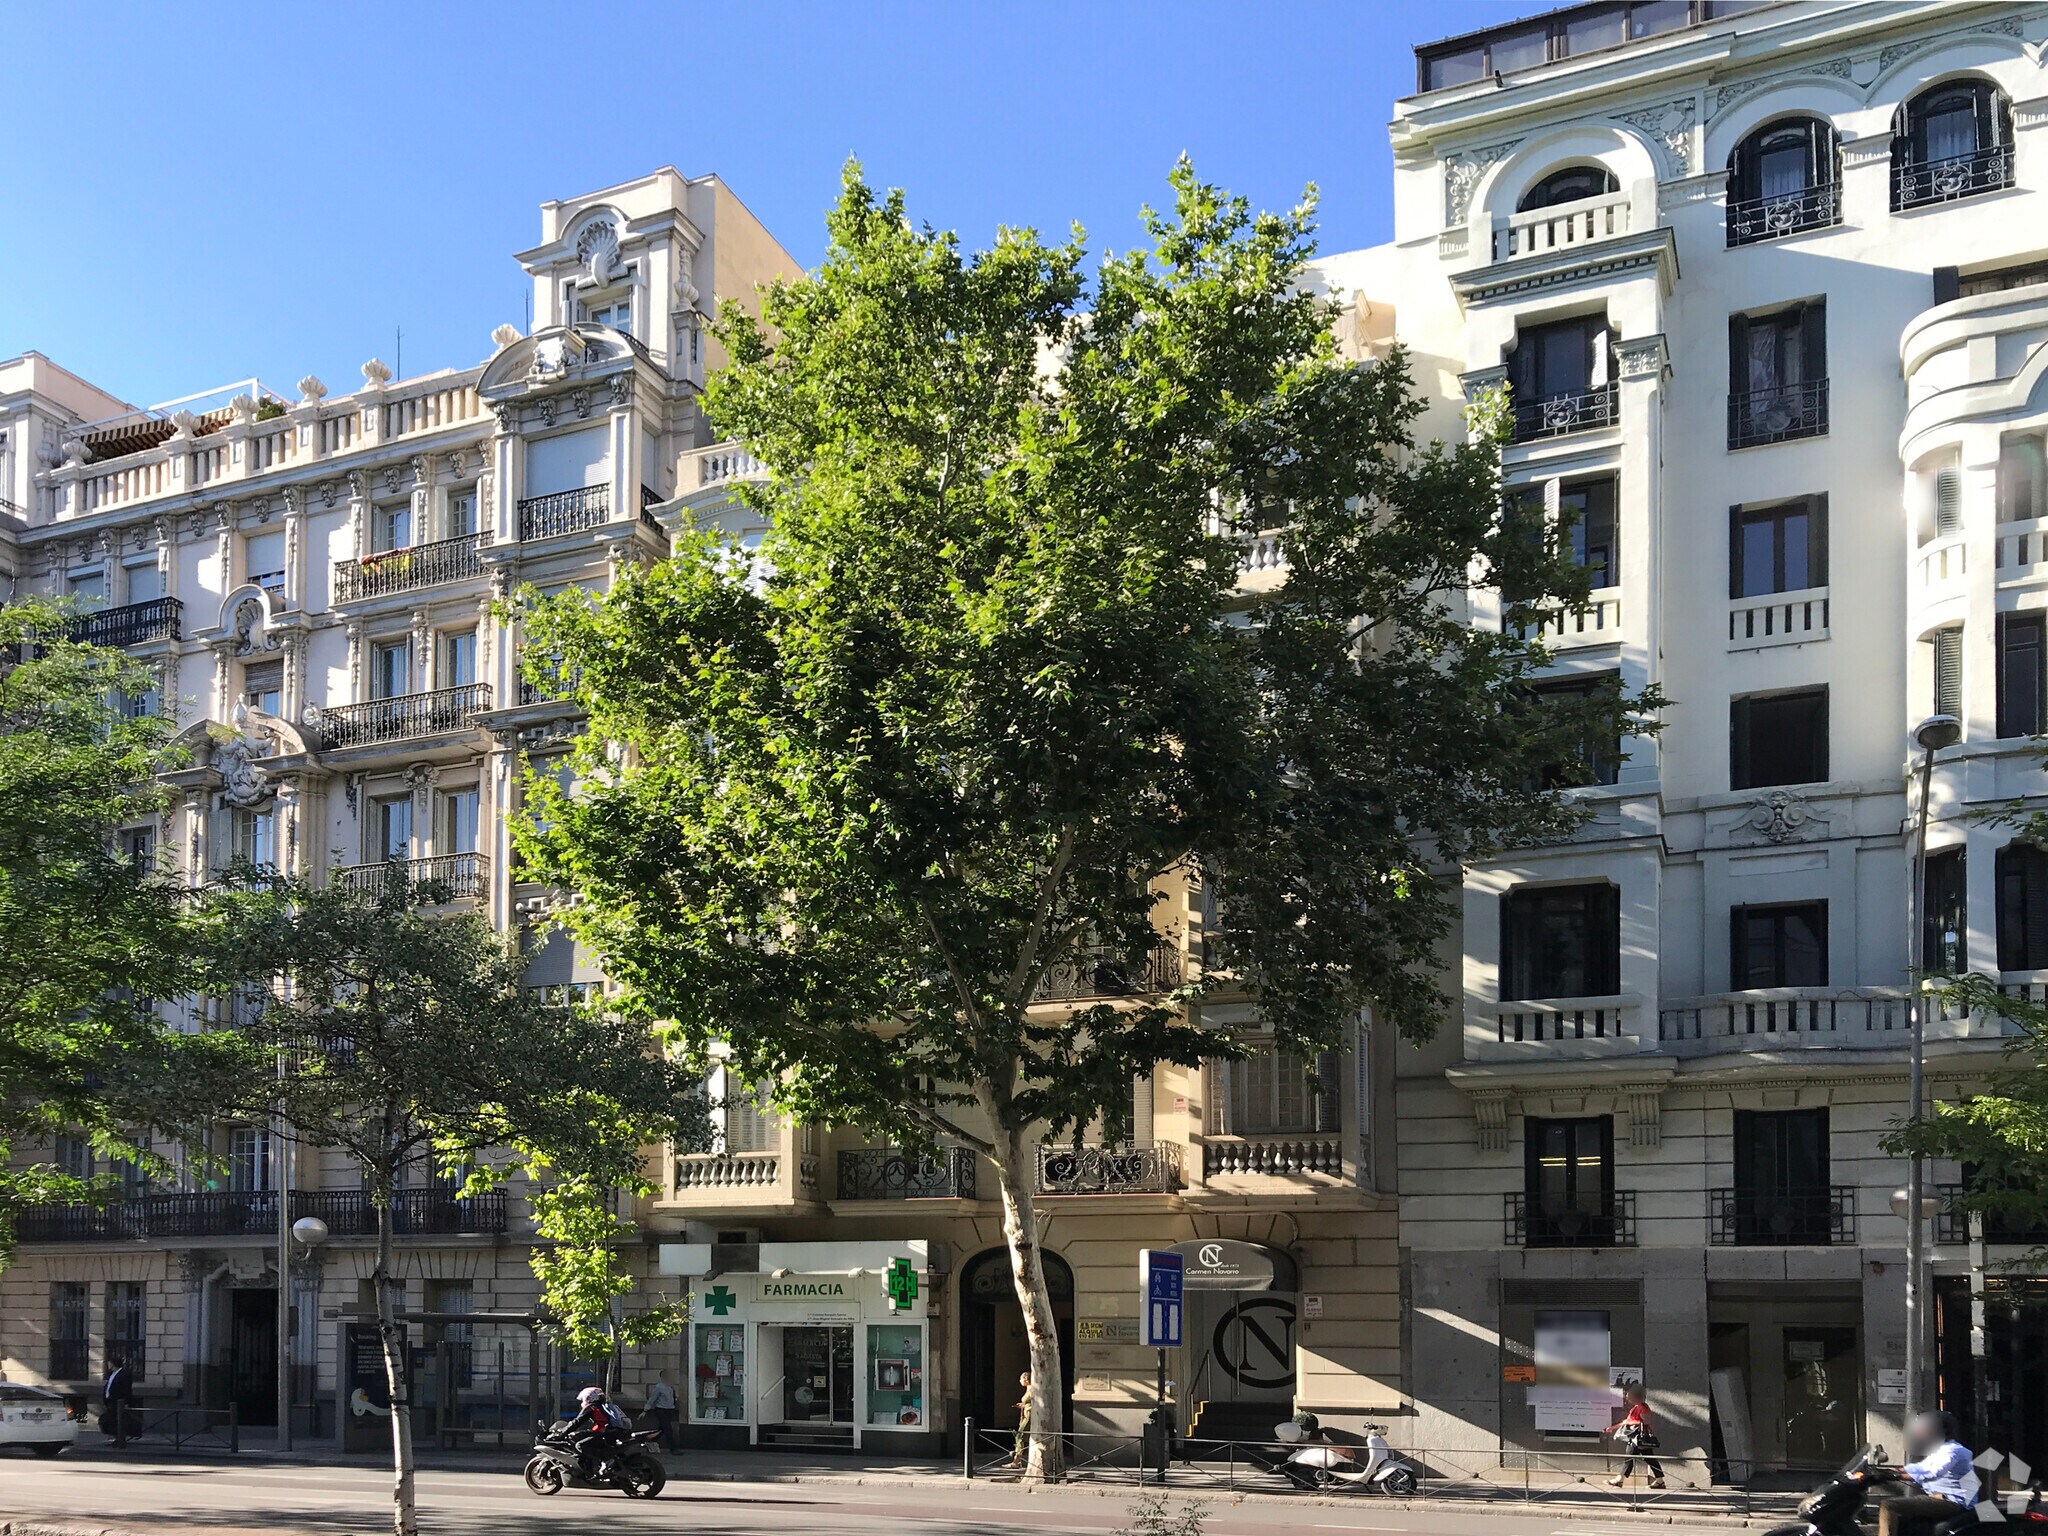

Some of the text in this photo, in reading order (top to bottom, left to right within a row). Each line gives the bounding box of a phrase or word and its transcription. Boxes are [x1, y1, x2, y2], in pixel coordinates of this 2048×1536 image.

[1185, 1267, 1240, 1275] Carmen Navarro
[764, 1283, 844, 1296] FARMACIA
[891, 1275, 914, 1292] 12H
